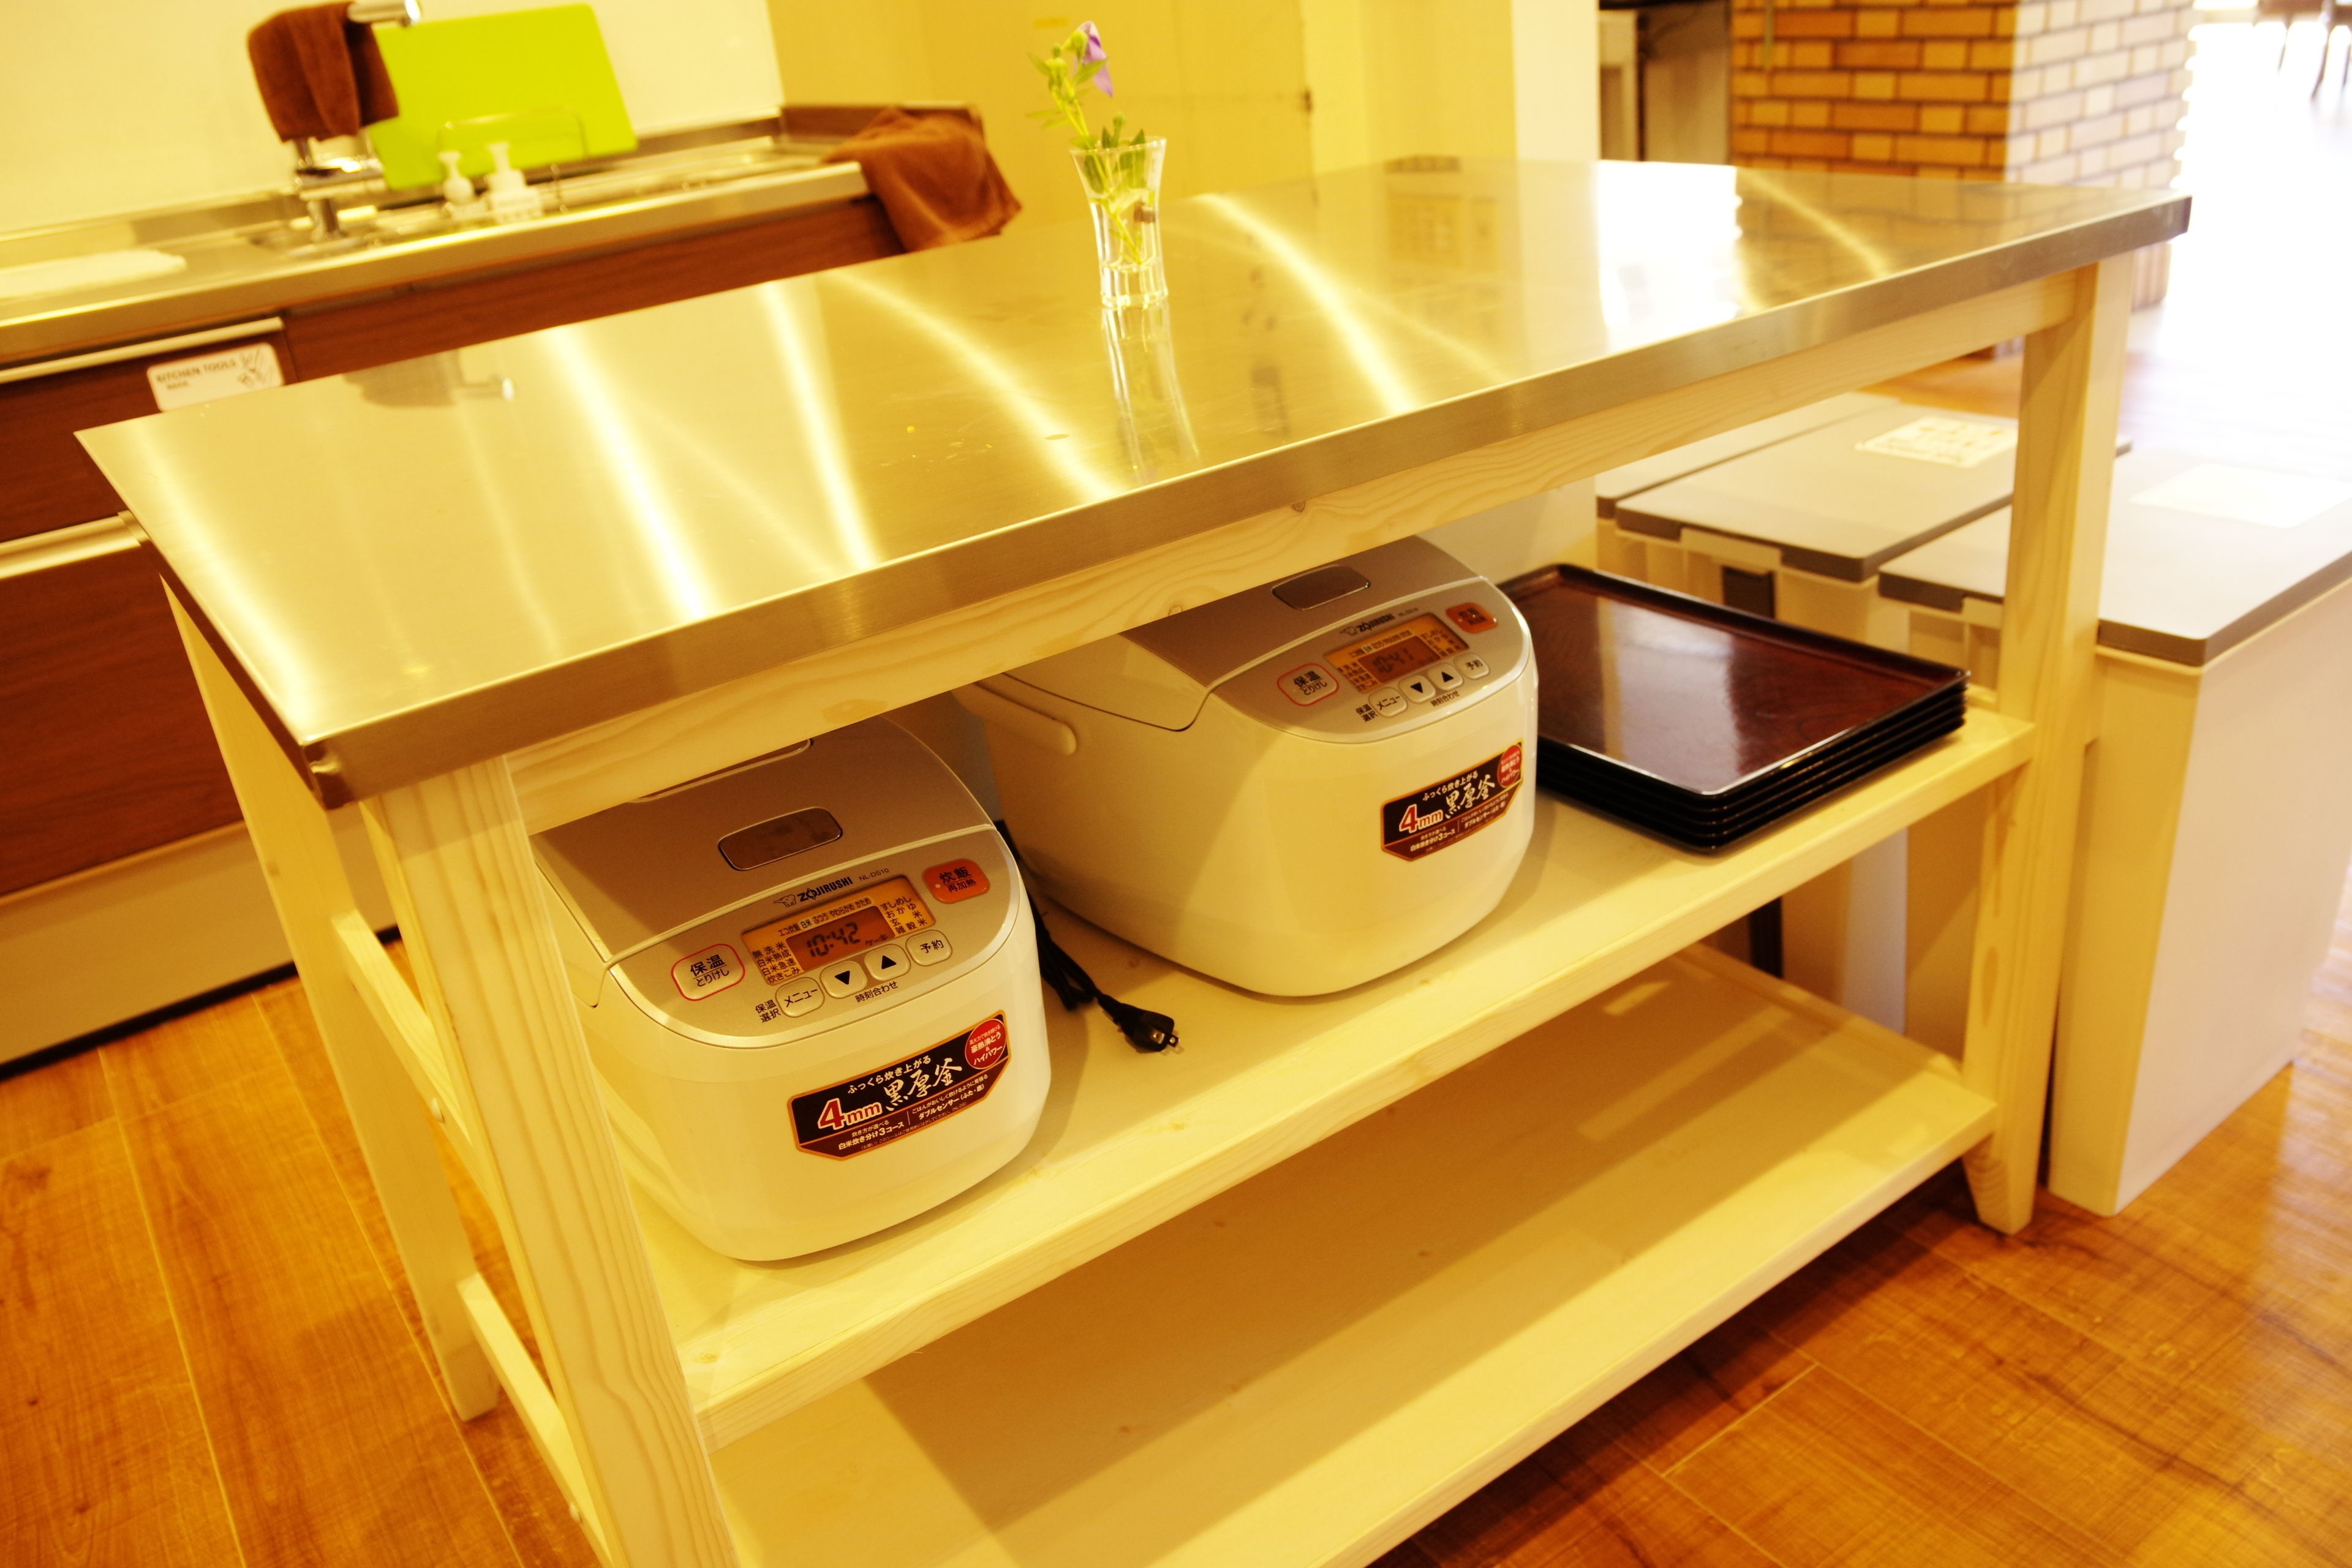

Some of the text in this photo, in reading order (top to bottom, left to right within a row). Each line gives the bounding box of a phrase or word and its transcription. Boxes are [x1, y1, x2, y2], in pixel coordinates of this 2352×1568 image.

[156, 368, 200, 382] KITCHEN
[1303, 681, 1327, 695] とりけし
[1377, 696, 1400, 710] メニュー
[1399, 804, 1443, 833] 4mm
[939, 867, 971, 884] 炊飯
[797, 868, 889, 902] ZOJIRUSHI NL-DS10
[946, 879, 978, 892] 再加熱
[880, 897, 911, 911] すしめし
[801, 919, 813, 929] 白米
[806, 922, 861, 957] 10:42
[920, 940, 944, 953] 予約
[690, 954, 725, 976] 保温
[757, 950, 791, 968] 白米熟成
[762, 958, 796, 976] 白米急速
[696, 968, 729, 987] とりけし
[767, 967, 800, 983] 炊きこみ
[784, 989, 818, 1008] メニュー
[855, 981, 898, 1003] 時刻合わせ
[755, 999, 777, 1014] 保温
[760, 1008, 781, 1023] 選択
[974, 1046, 1003, 1065] ハイパワー
[848, 1055, 931, 1094] ふっくら炊き上がる
[817, 1058, 962, 1131] 4mm 黒厚釜
[839, 1121, 904, 1150] 白米炊き分け3コース
[852, 1120, 889, 1137] 炊き方が選べる
